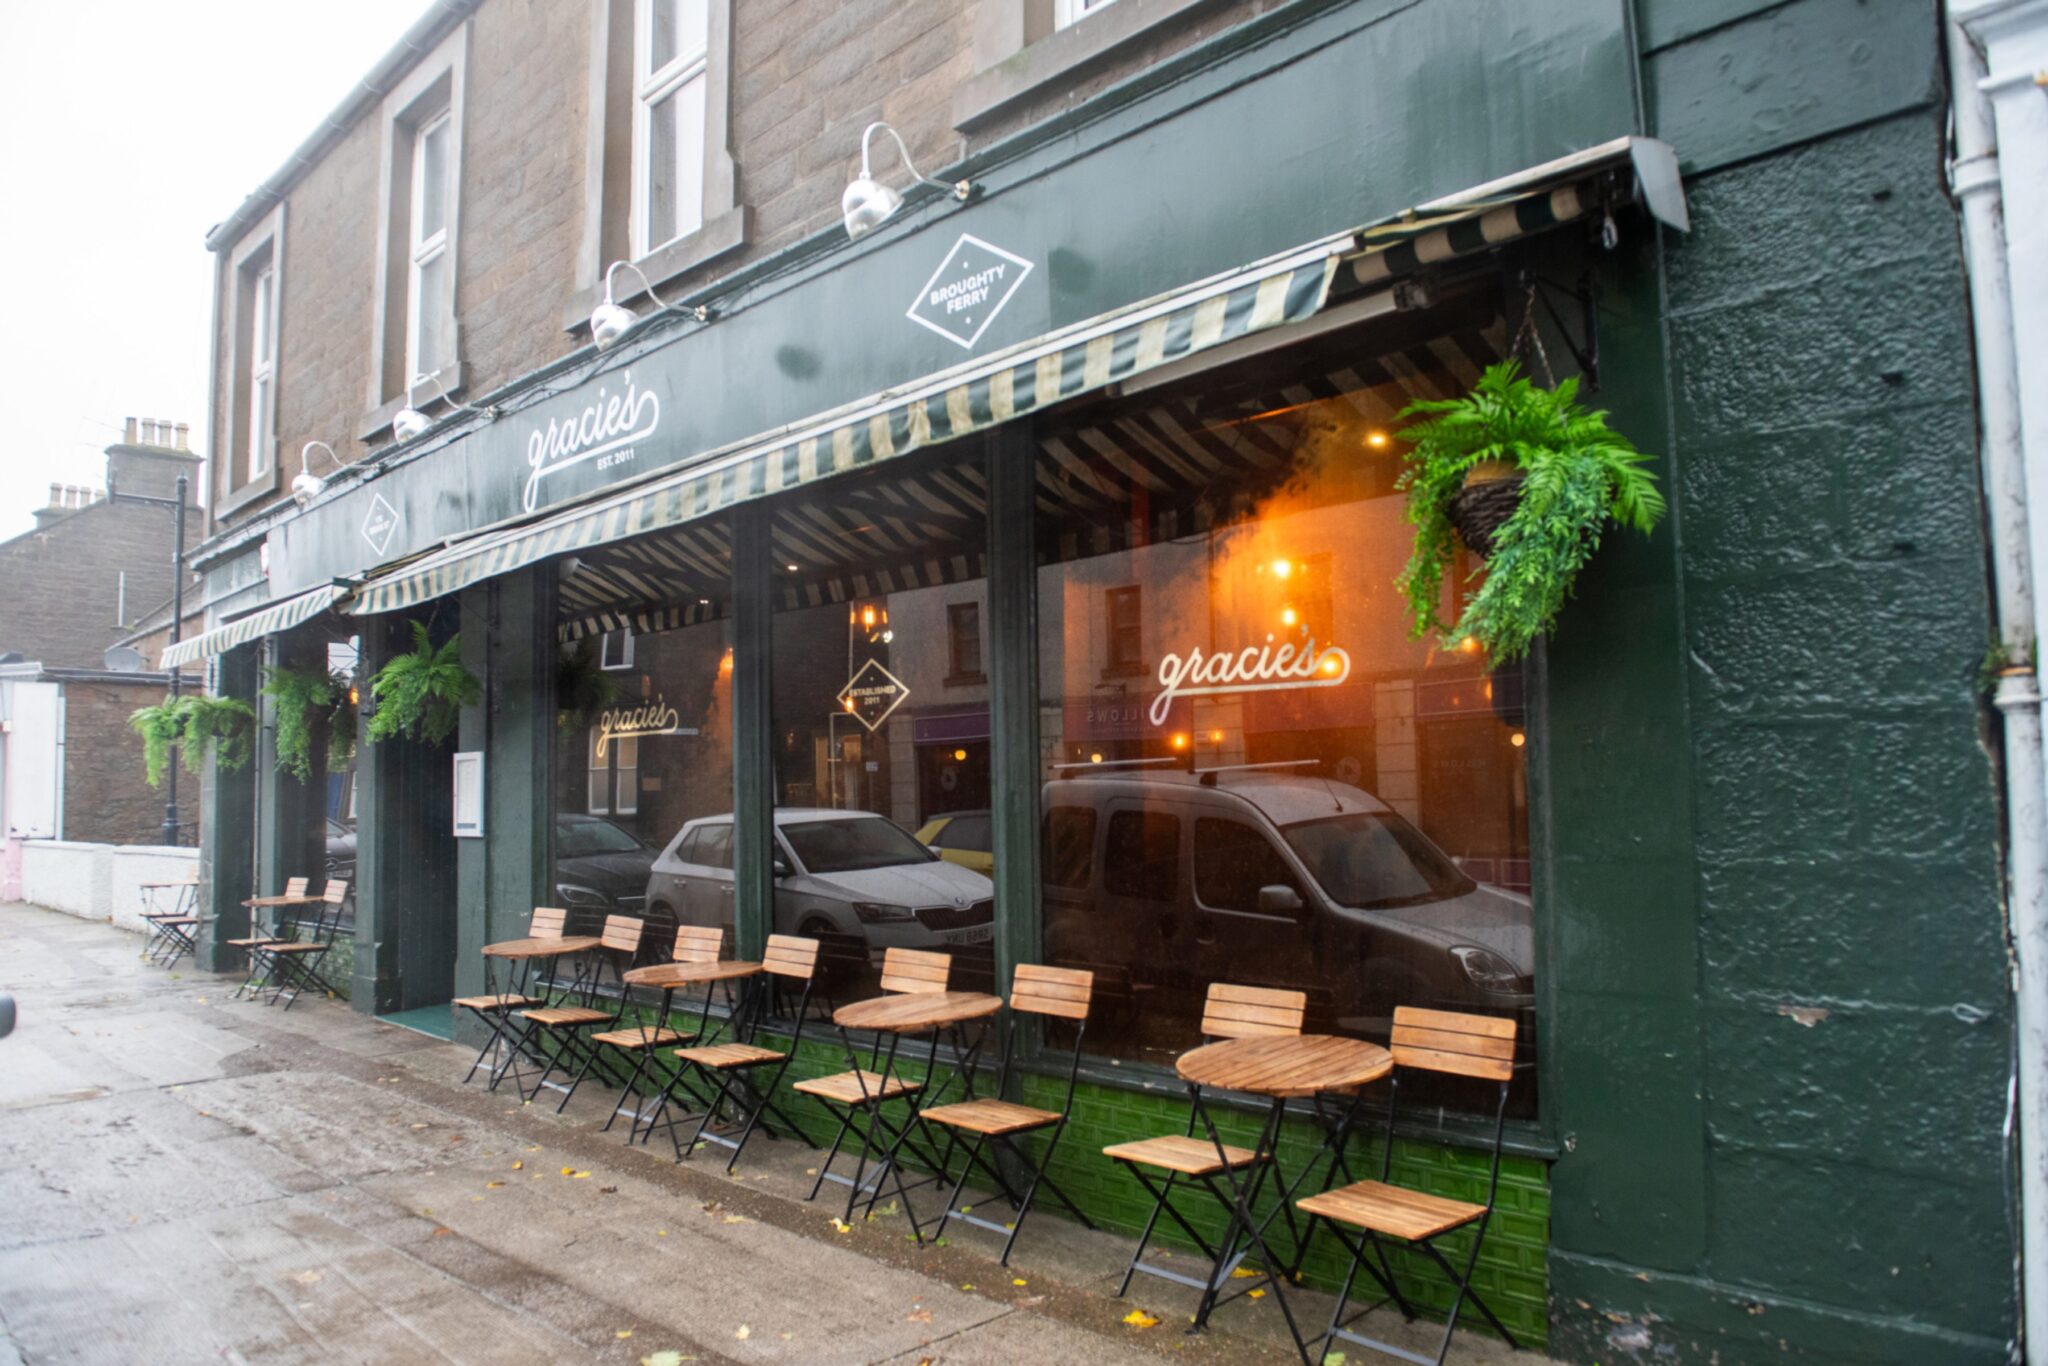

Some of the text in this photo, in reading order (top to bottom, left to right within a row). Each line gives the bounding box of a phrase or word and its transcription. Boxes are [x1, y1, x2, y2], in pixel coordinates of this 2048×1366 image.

[930, 264, 1005, 306] BROUGHTY
[946, 286, 989, 315] FERRY
[523, 369, 660, 514] gracie's
[597, 447, 635, 471] EST. 2011
[1149, 623, 1351, 726] gracie's
[595, 692, 679, 759] gracie's
